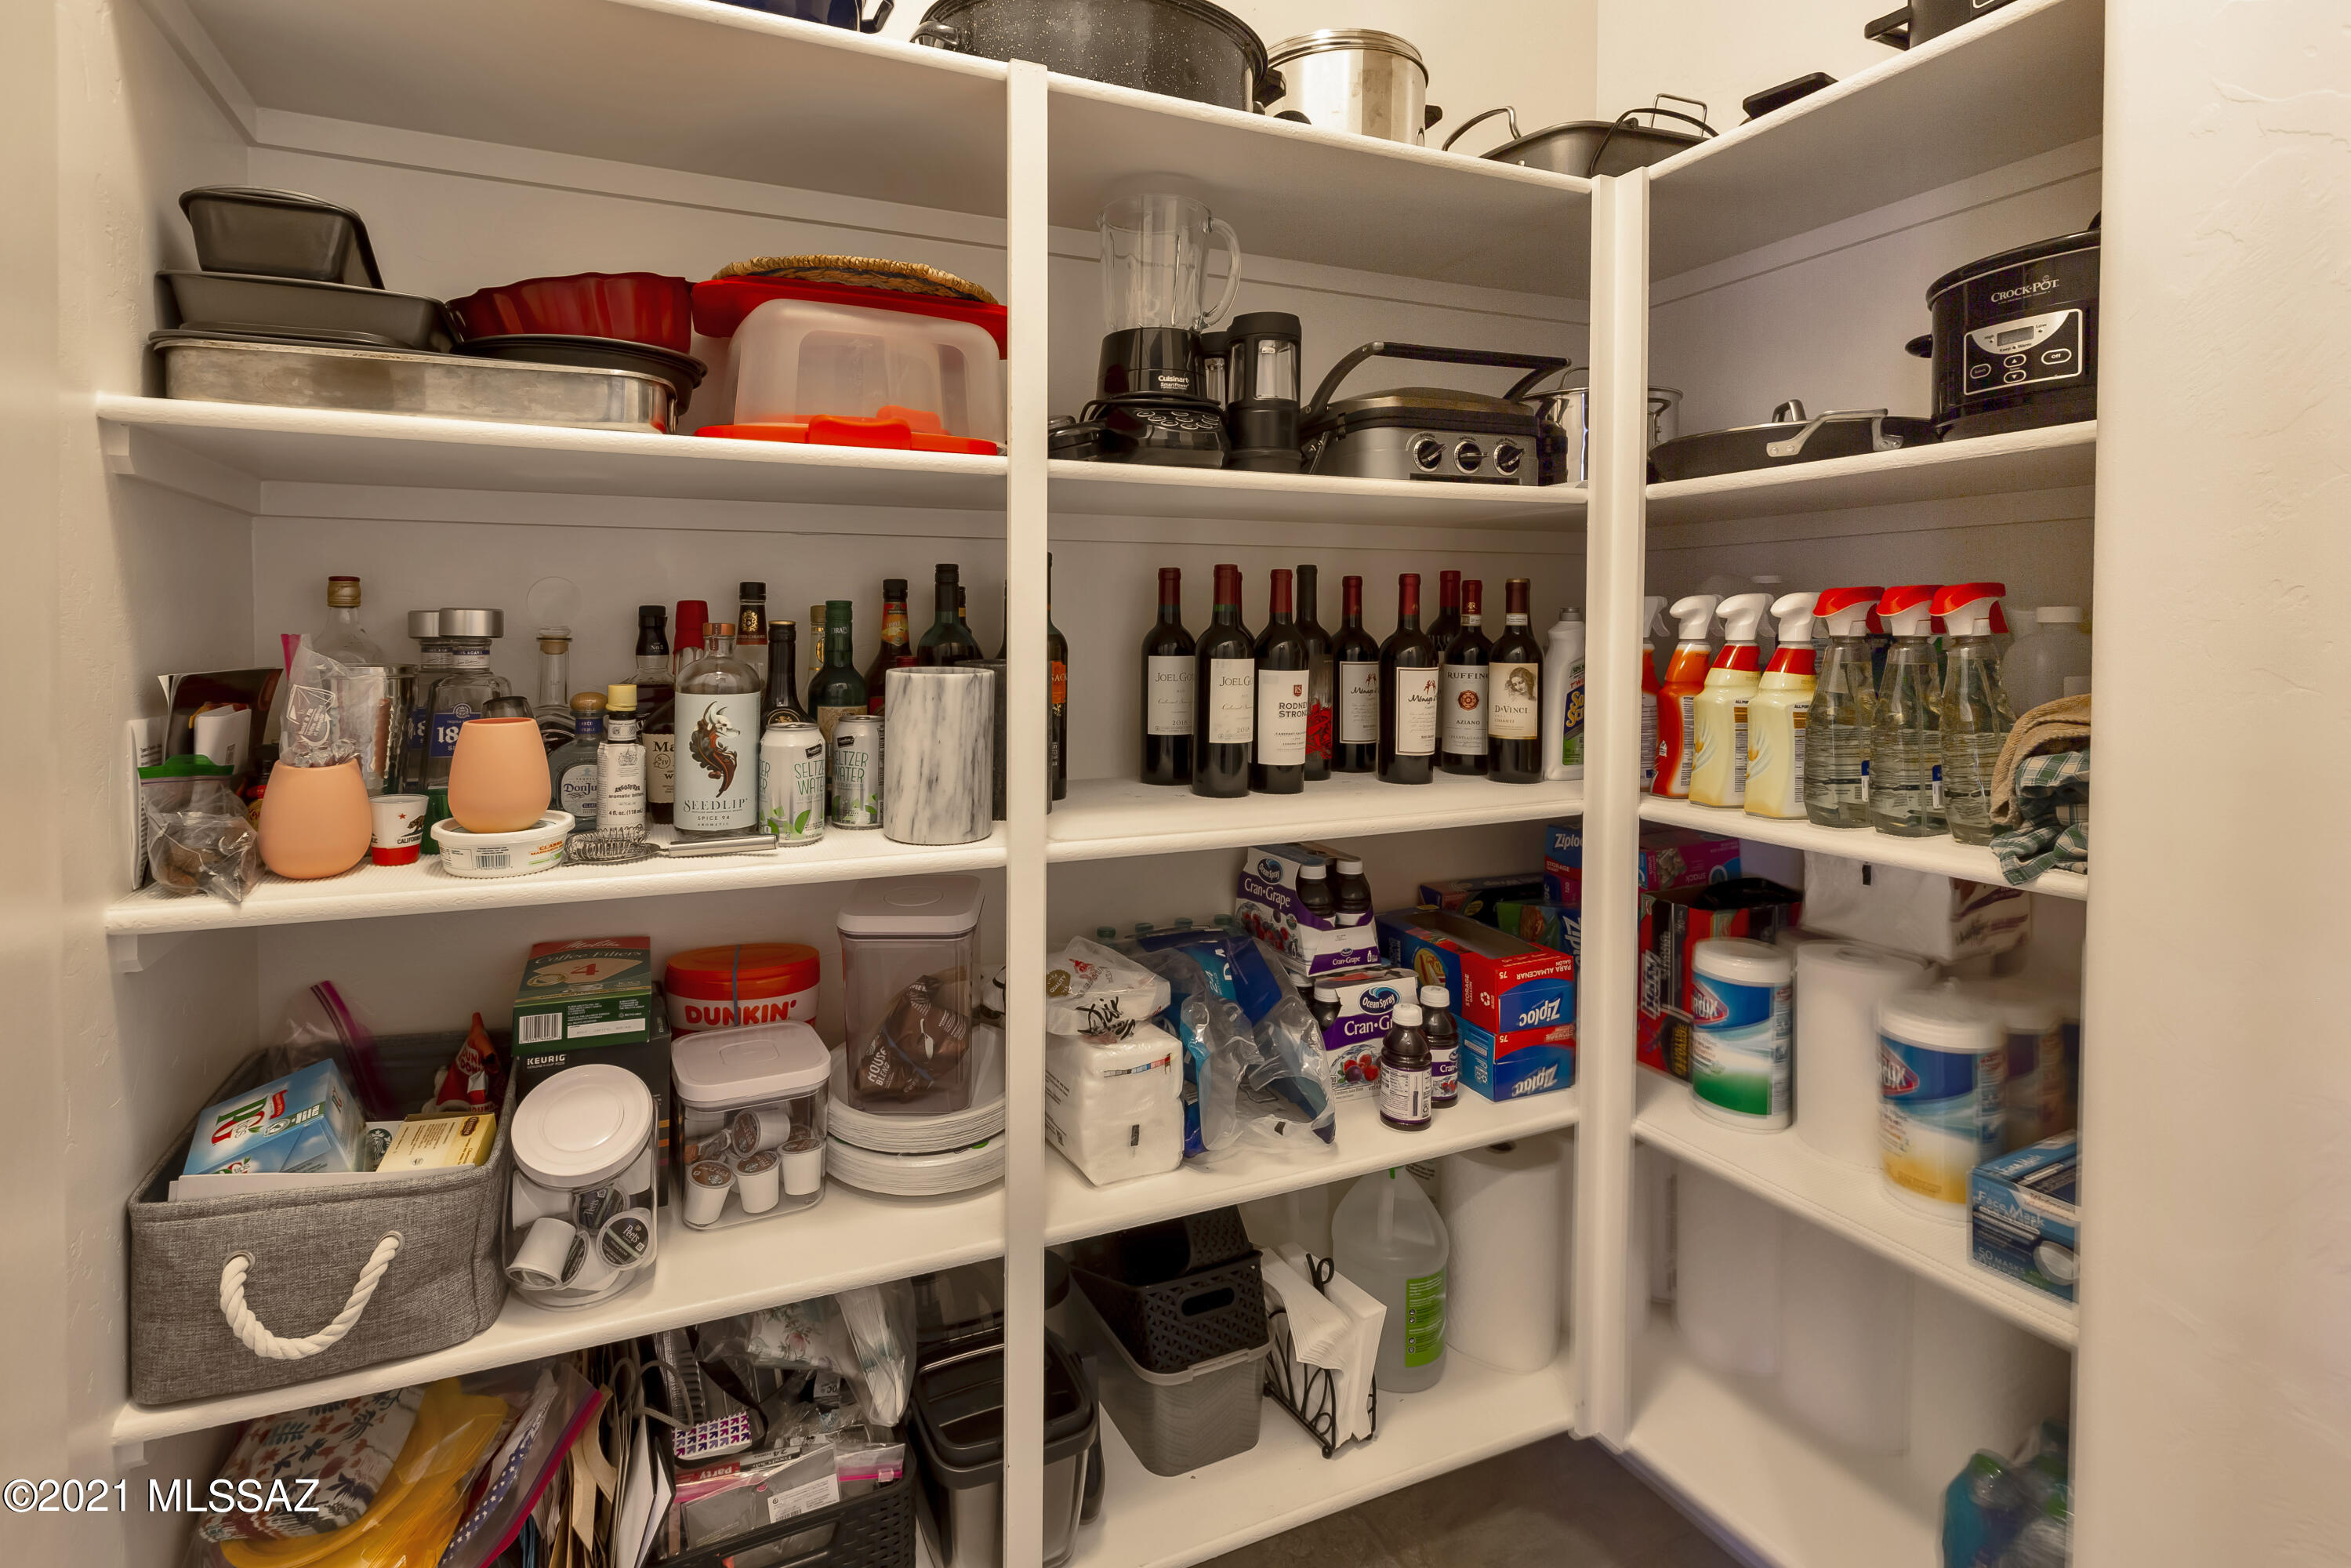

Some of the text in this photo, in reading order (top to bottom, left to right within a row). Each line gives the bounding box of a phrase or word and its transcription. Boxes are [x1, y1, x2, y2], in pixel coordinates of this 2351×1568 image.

[1158, 375, 1188, 383] Cuisinart
[1156, 672, 1178, 682] JOEL
[1220, 676, 1243, 687] JOEL
[684, 799, 746, 812] SEEDLIP
[535, 953, 587, 964] Coffee
[571, 964, 599, 976] 4
[1499, 971, 1507, 979] 75
[1516, 967, 1554, 980] ALMACENAR
[1050, 974, 1067, 993] QUALITY
[1362, 994, 1395, 1010] Ocean Spray
[1518, 997, 1561, 1027] Ziploc
[527, 1054, 566, 1066] KEURIG
[876, 1062, 890, 1086] BLEND
[699, 1465, 733, 1481] party
